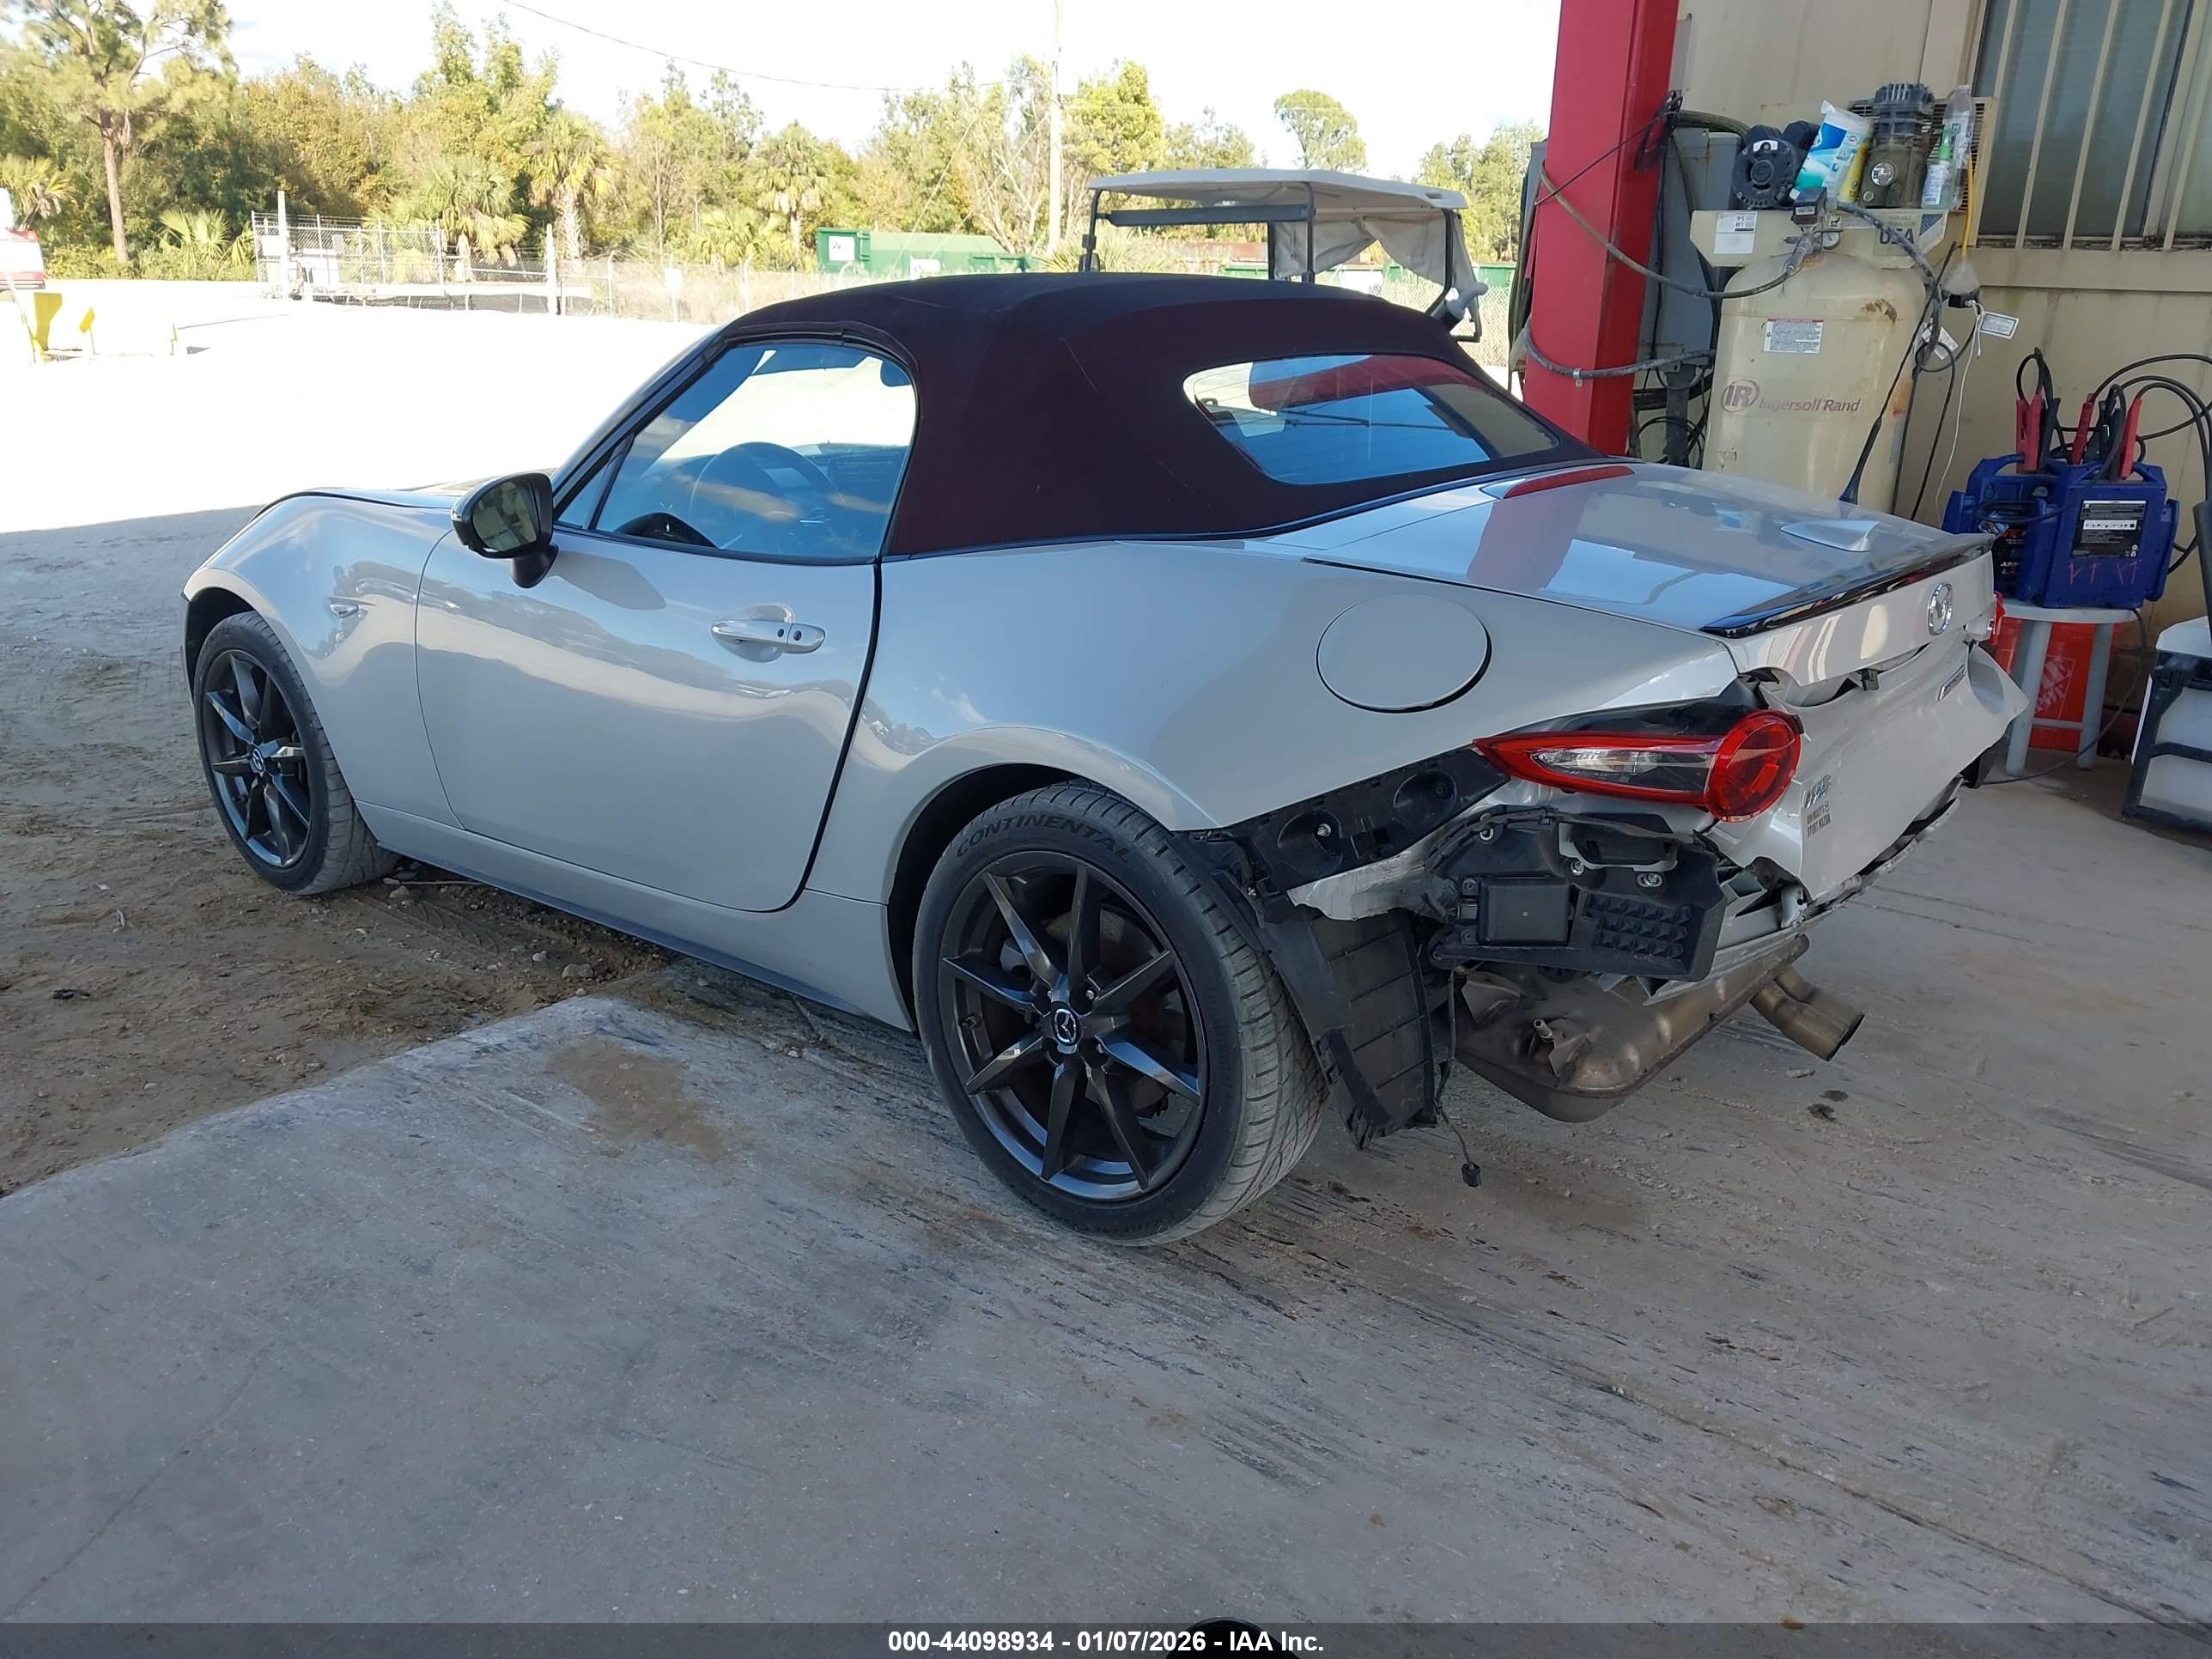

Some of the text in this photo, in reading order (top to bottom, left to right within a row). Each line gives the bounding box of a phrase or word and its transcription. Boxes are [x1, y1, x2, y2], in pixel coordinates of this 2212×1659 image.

[1759, 398, 1862, 413] Ingersoll Rand
[957, 813, 1130, 861] CONTINENTAL
